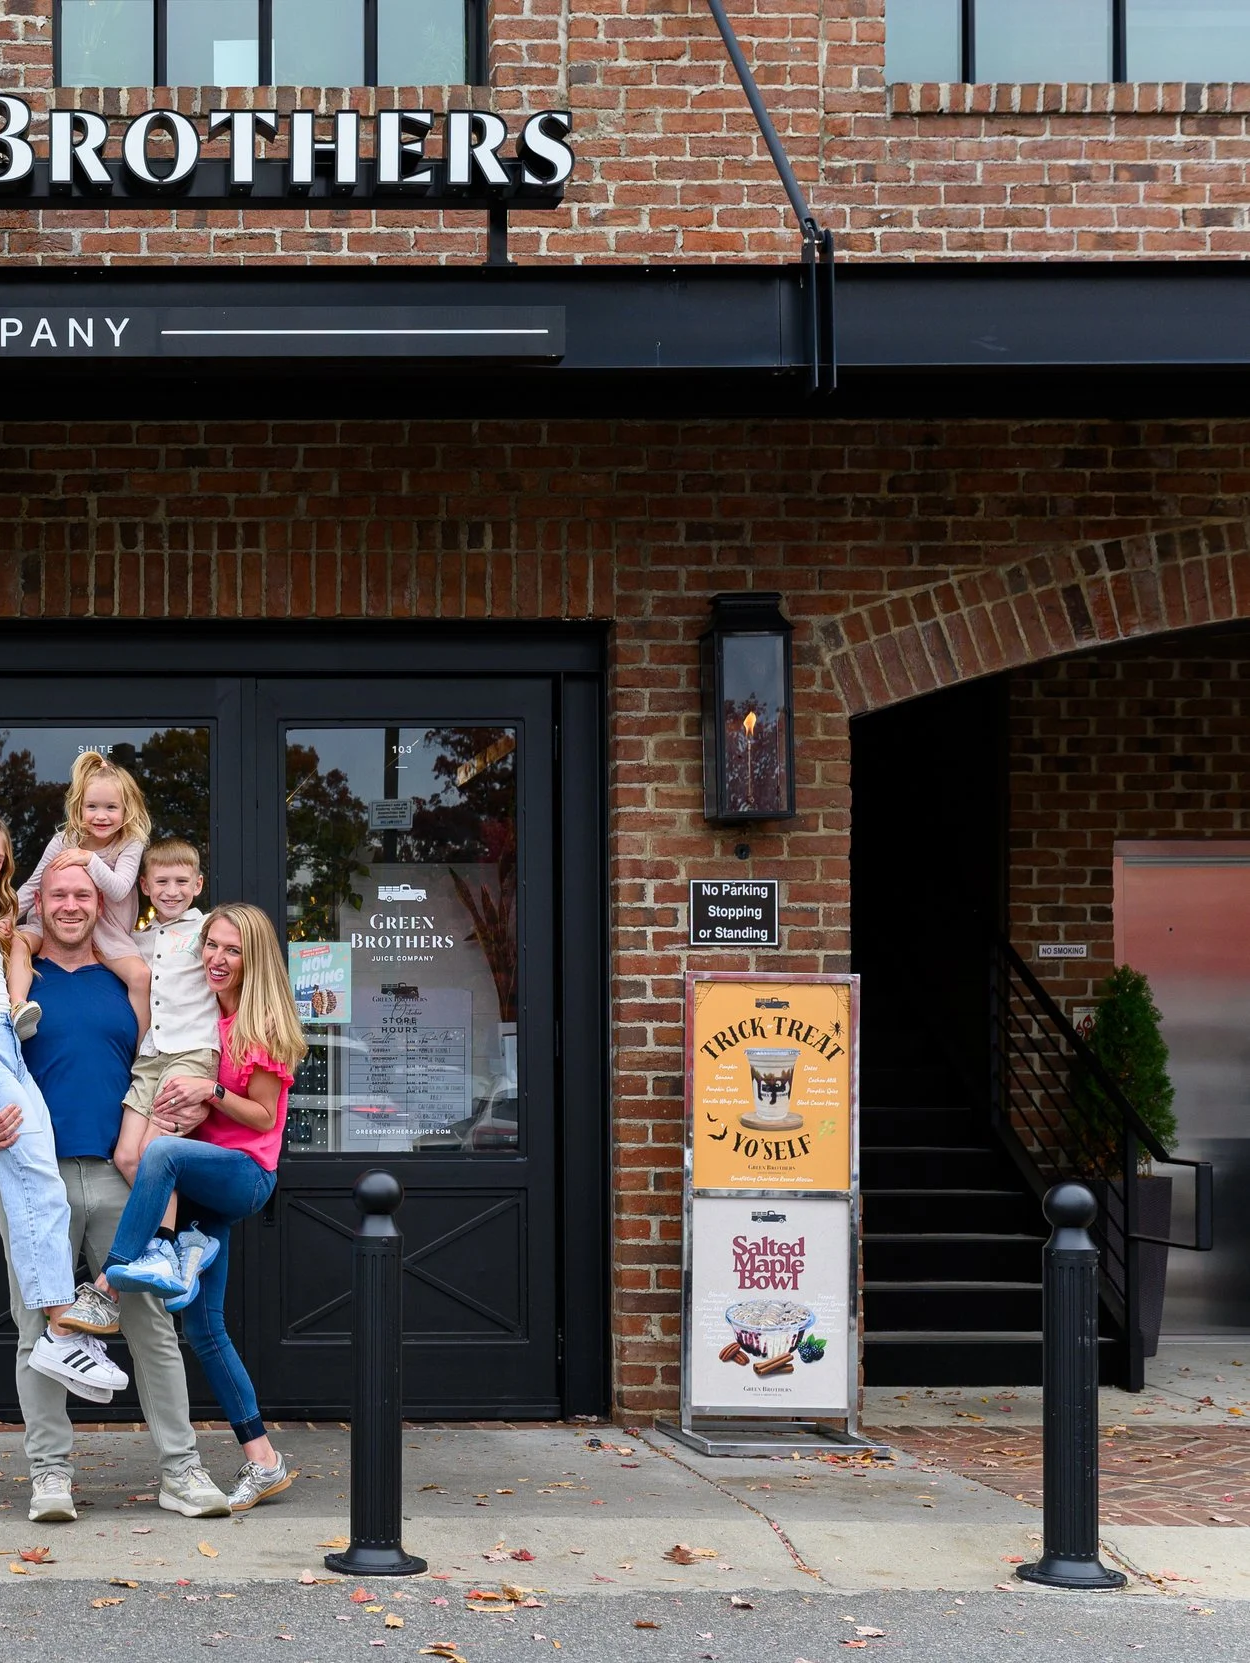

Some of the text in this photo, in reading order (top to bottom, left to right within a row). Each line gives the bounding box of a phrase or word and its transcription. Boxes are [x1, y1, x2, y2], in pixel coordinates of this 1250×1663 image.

[77, 745, 114, 754] SUITE
[391, 745, 412, 754] 103
[701, 883, 769, 899] No Parking
[707, 904, 762, 920] Stopping
[369, 913, 435, 930] GREEN
[351, 932, 455, 949] BROTHERS
[698, 926, 768, 941] or Standing
[1041, 947, 1084, 955] NO SMOKING
[301, 954, 334, 973] NOW
[296, 968, 345, 991] HIRING
[382, 1016, 417, 1024] STORE
[699, 1016, 768, 1061] TRICK
[772, 1016, 846, 1062] TREAT
[732, 1131, 811, 1161] YO'SELF
[732, 1235, 806, 1257] Salted
[732, 1253, 805, 1278] Maple
[738, 1270, 799, 1290] Bowl
